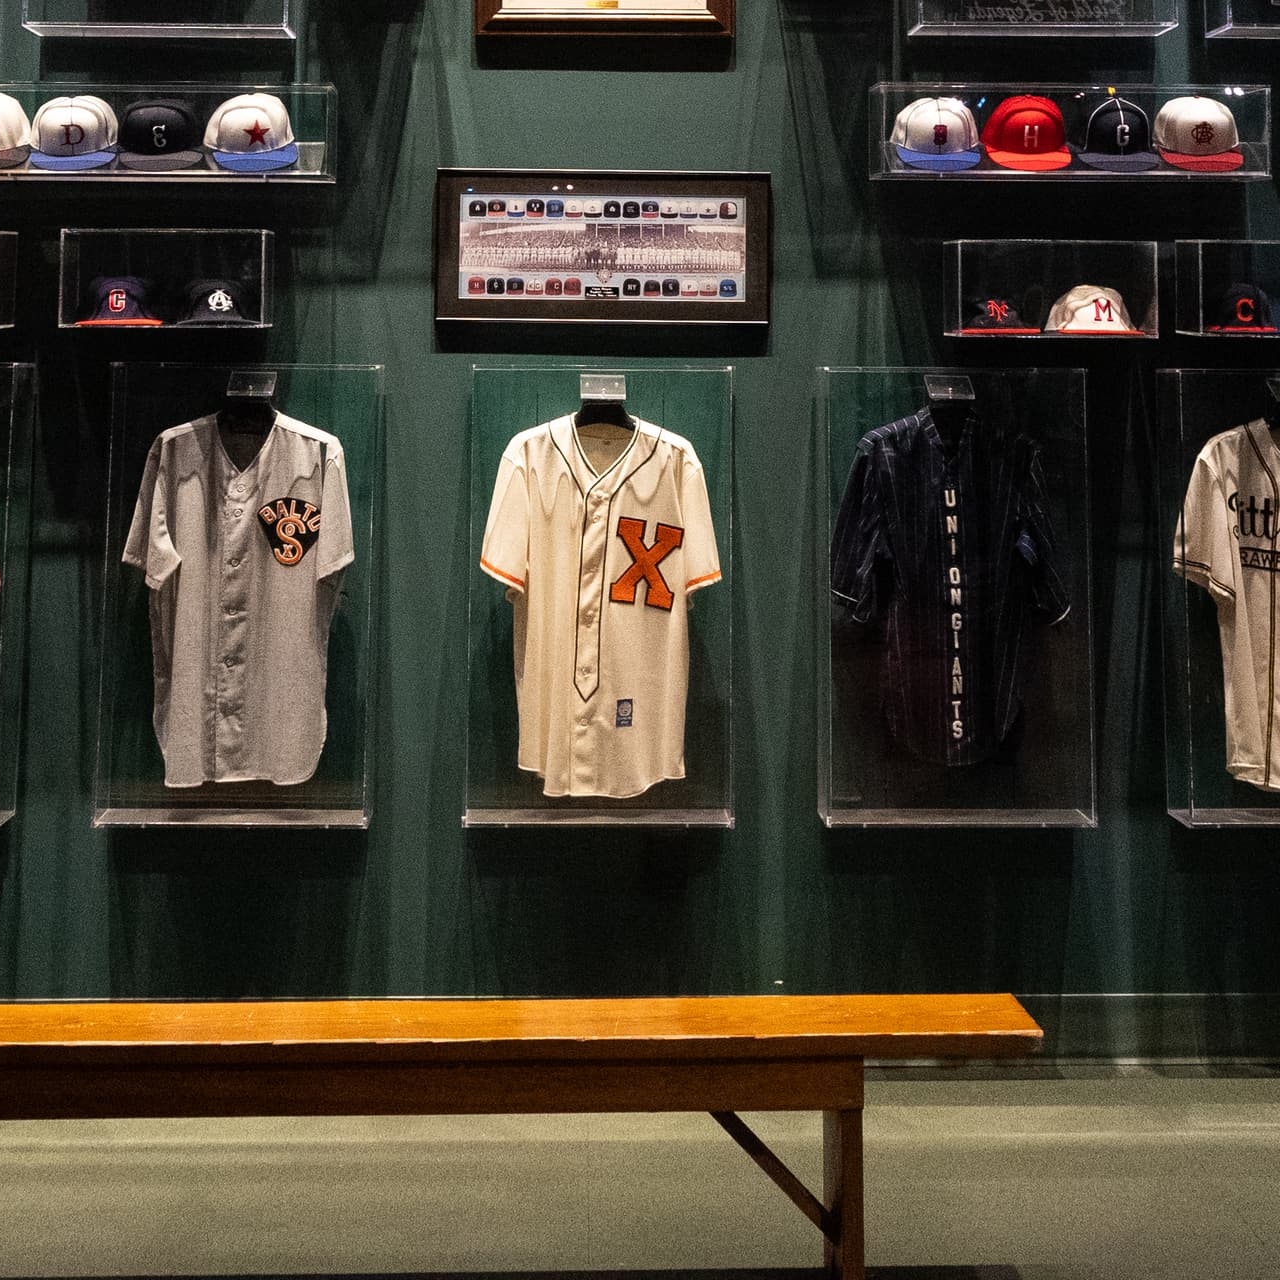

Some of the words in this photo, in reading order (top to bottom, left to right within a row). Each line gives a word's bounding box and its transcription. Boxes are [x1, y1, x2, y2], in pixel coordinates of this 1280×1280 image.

[60, 124, 84, 146] D
[1024, 125, 1039, 148] H
[1093, 299, 1113, 322] M
[1235, 298, 1256, 323] C
[609, 516, 684, 611] X
